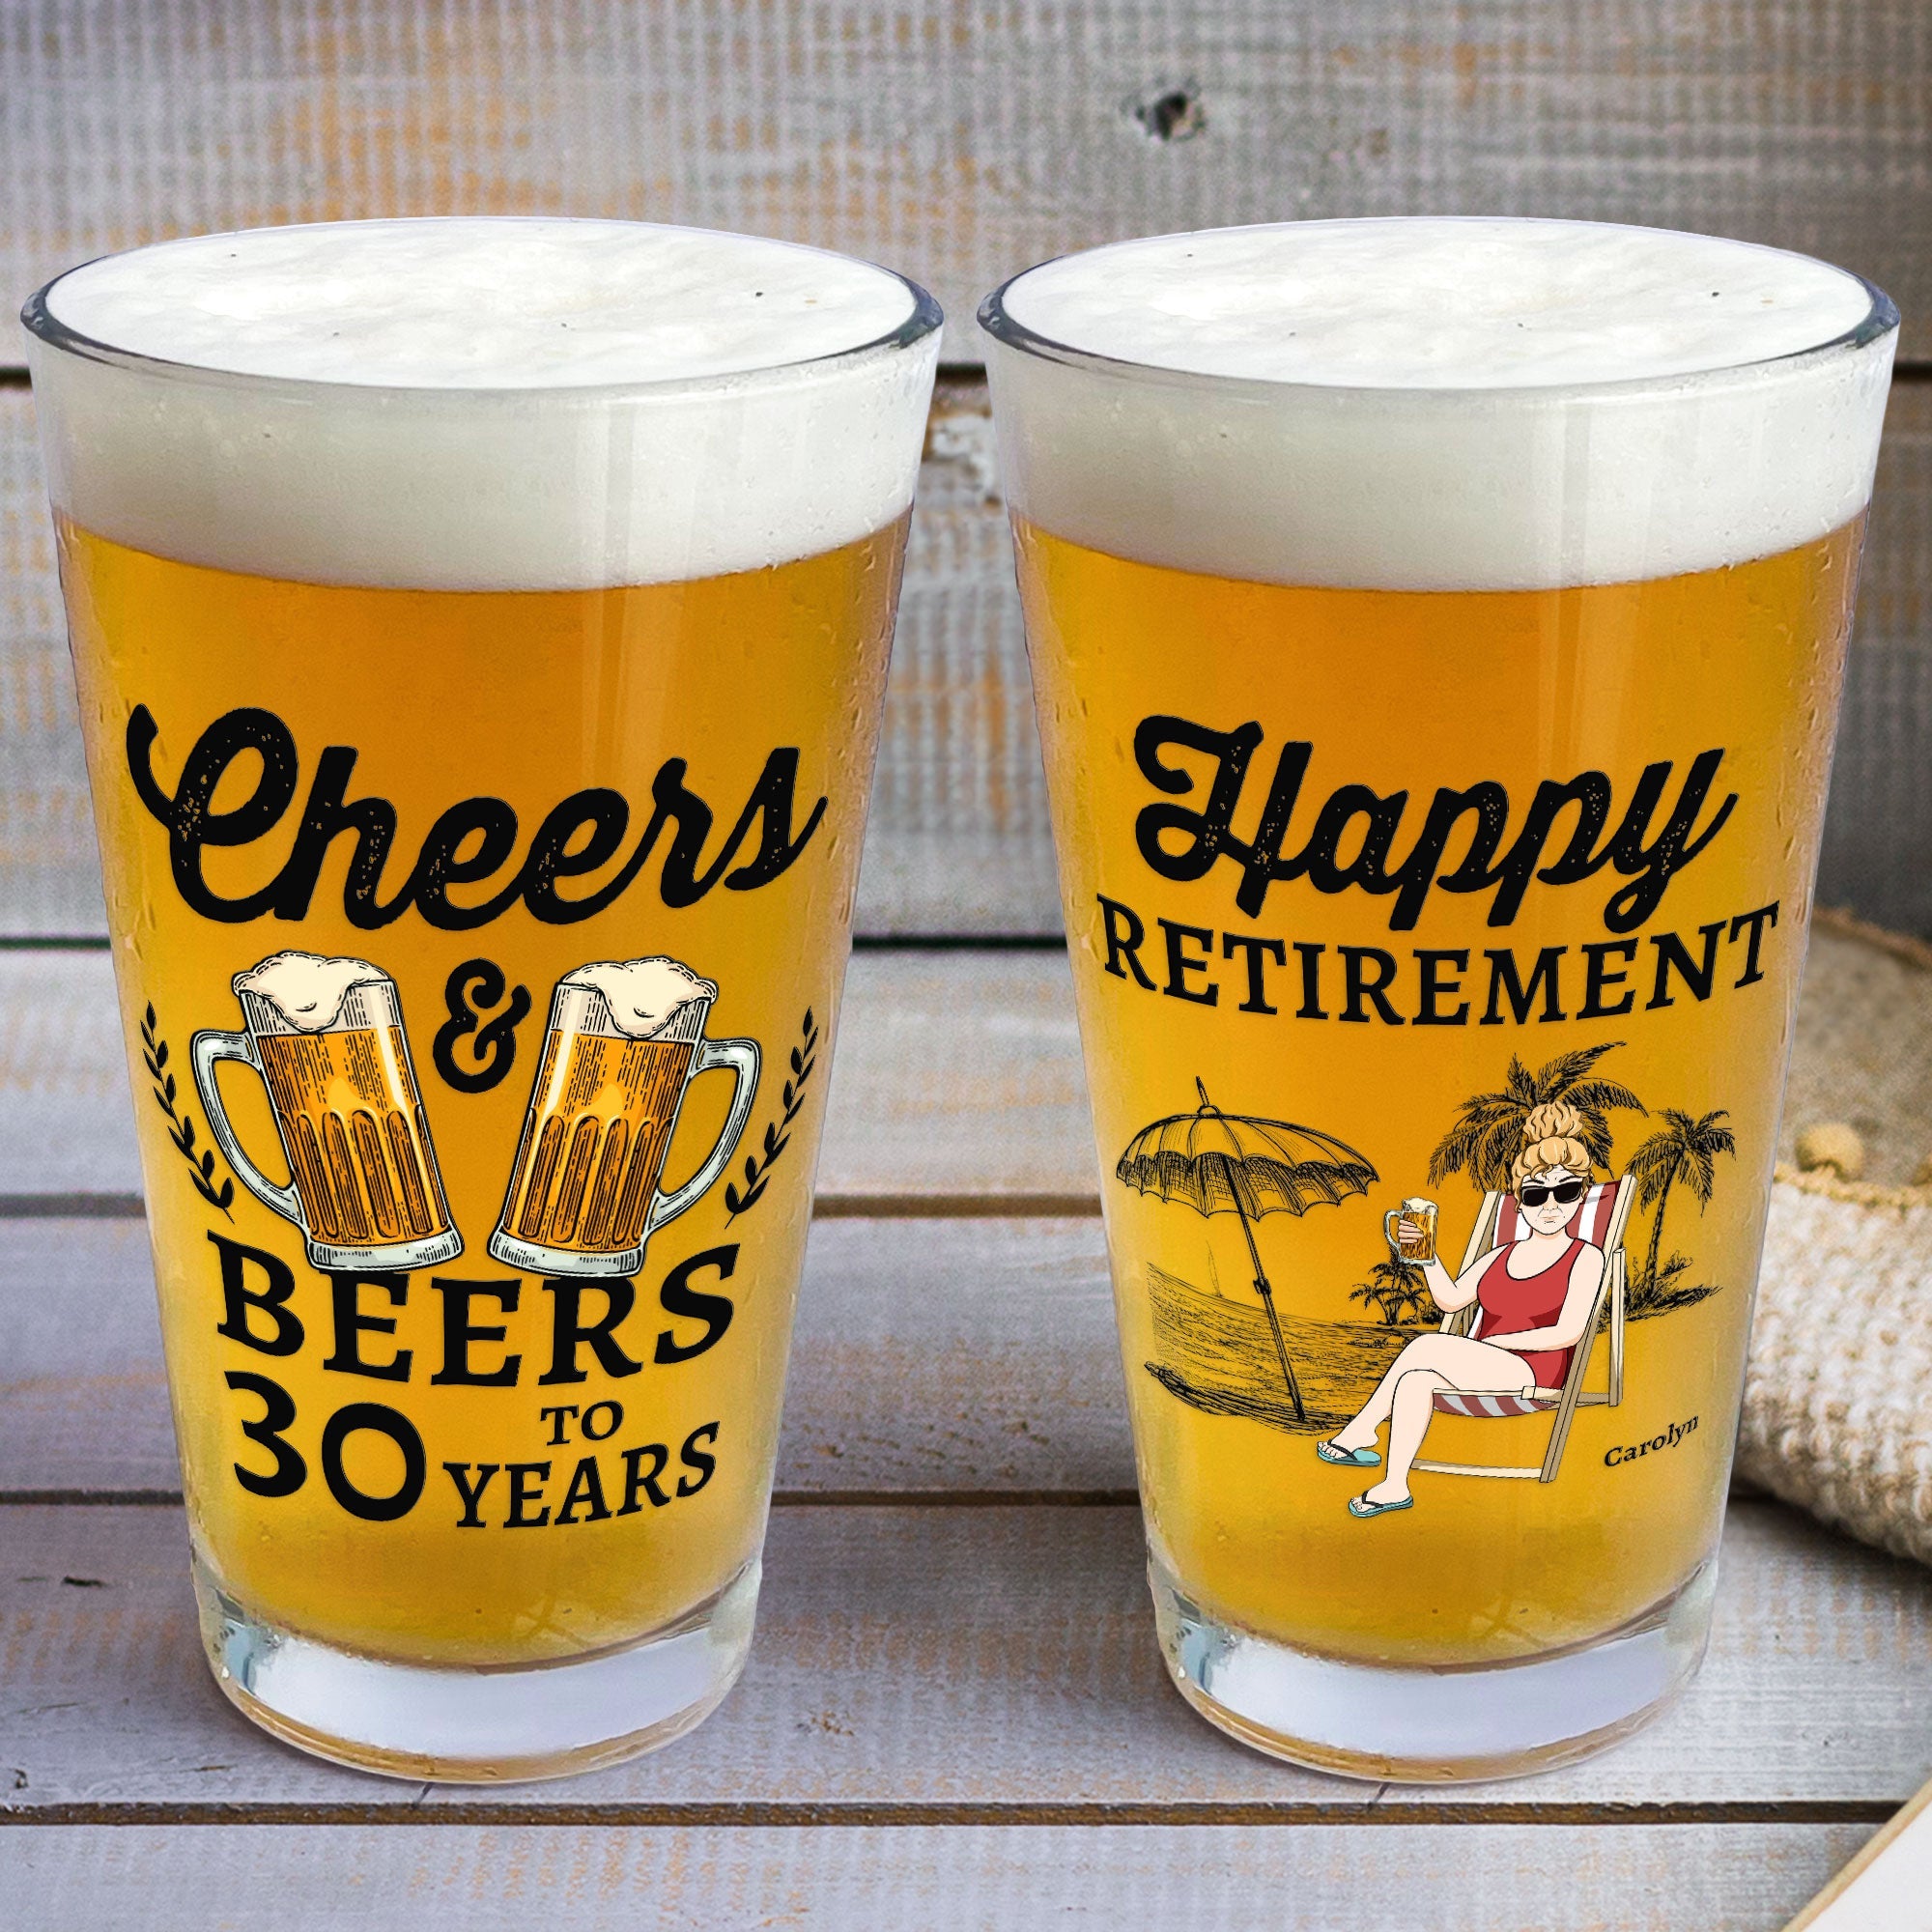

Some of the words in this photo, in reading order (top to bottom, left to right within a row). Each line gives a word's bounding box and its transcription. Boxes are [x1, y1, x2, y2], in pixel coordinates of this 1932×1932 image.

[127, 703, 828, 931] Cheers
[1134, 716, 1738, 934] Happy
[433, 958, 531, 1094] &
[1097, 894, 1779, 1026] RETIREMENT
[207, 1229, 741, 1387] BEERS
[224, 1371, 427, 1522] 30
[442, 1421, 719, 1528] YEARS
[540, 1401, 623, 1446] TO
[1604, 1415, 1700, 1468] Carolyn
